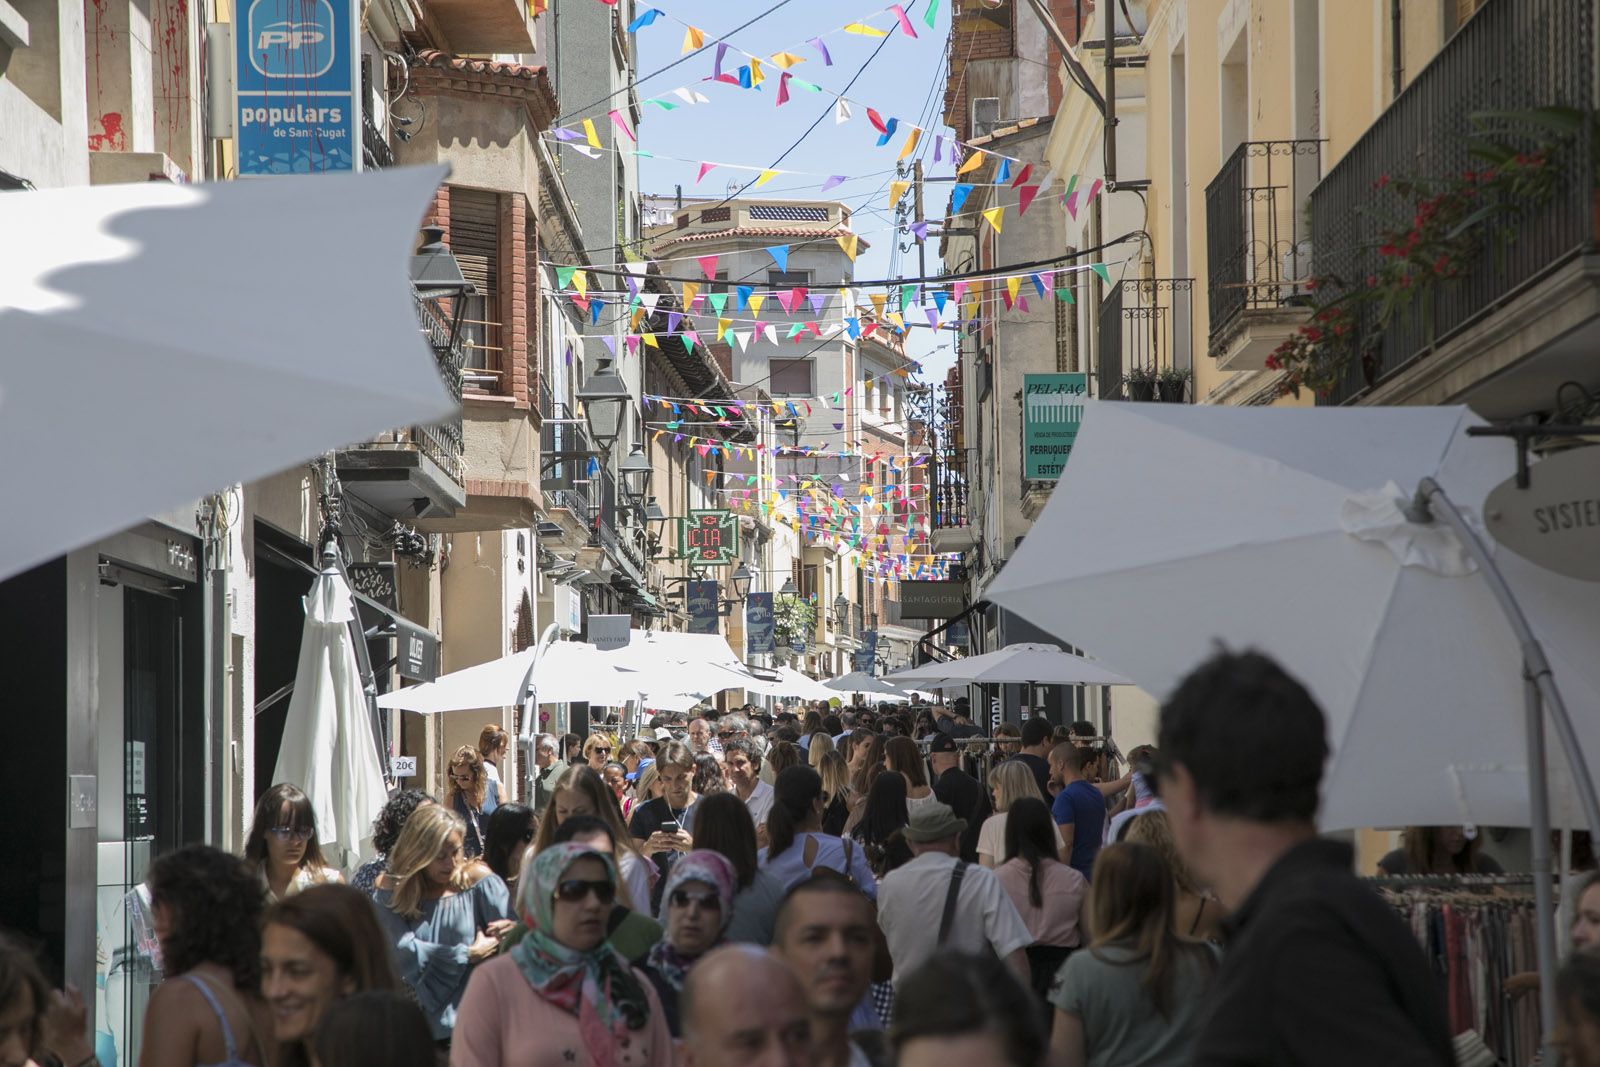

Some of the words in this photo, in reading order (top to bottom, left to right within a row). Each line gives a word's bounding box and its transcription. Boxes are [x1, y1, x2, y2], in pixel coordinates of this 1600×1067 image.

[258, 31, 325, 50] PP
[241, 104, 342, 127] populars
[273, 127, 287, 138] de
[289, 127, 313, 138] Sant
[315, 128, 346, 140] Cugat
[1030, 445, 1072, 456] PERRUQUER
[1533, 499, 1600, 534] SYSTE
[688, 528, 721, 546] CIA
[396, 761, 414, 770] 20€
